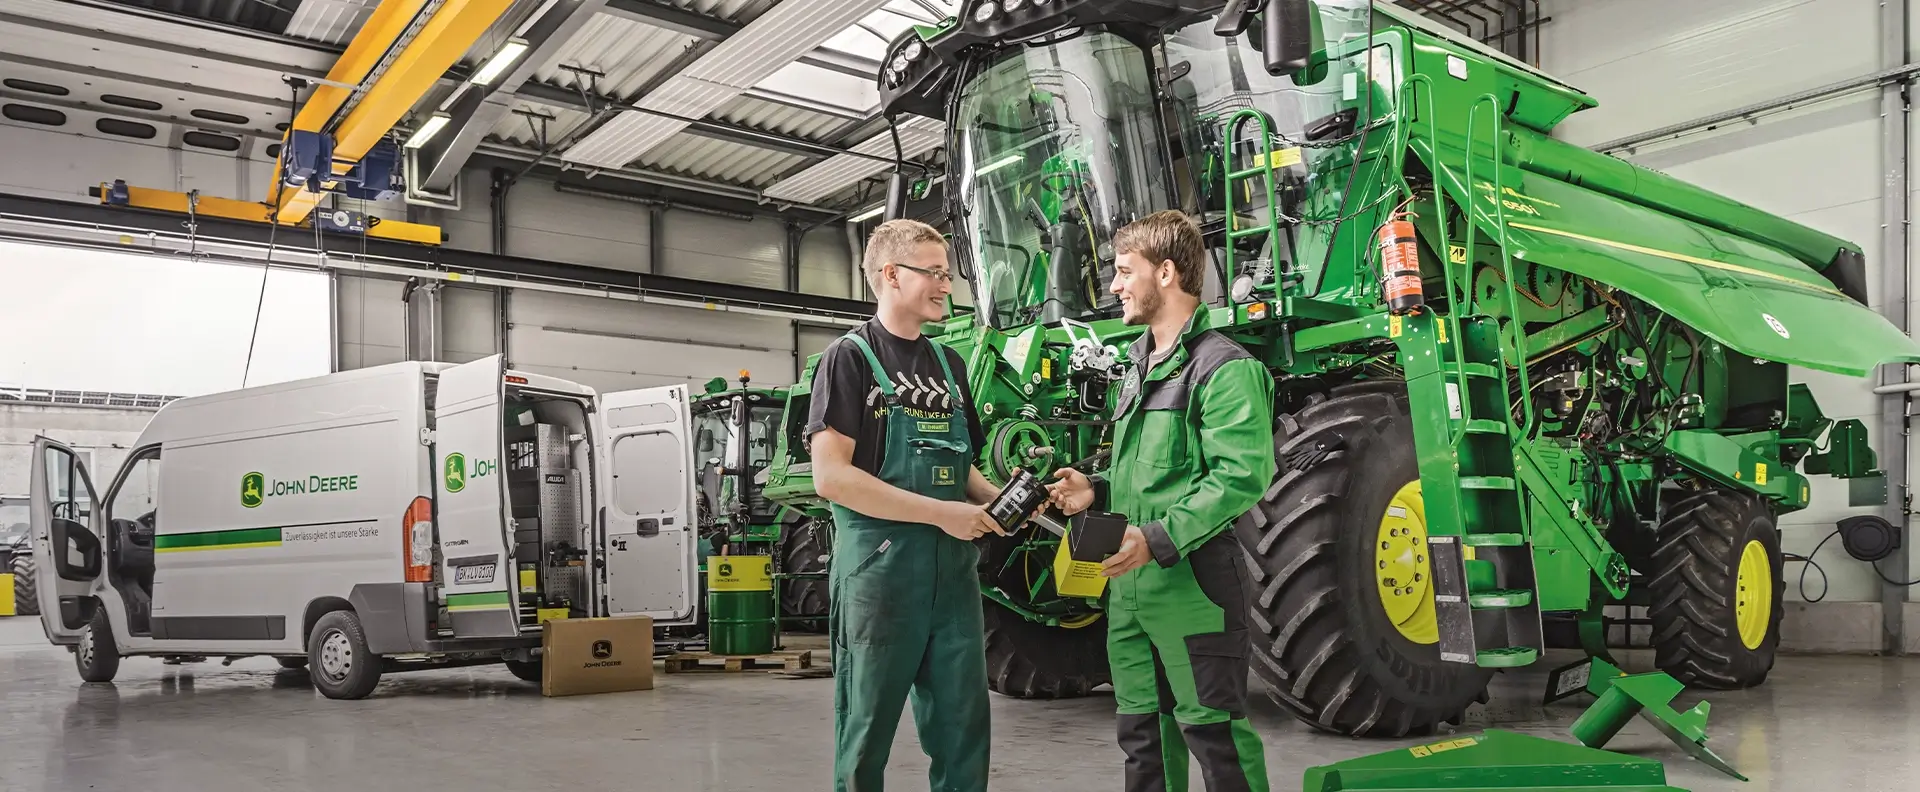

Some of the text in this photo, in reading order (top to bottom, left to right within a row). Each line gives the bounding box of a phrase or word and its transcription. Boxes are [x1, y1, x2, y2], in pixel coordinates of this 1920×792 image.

[904, 407, 923, 418] RUNS
[470, 458, 497, 478] JOH
[267, 475, 358, 497] JOHN DEERE
[285, 530, 328, 543] Zuverlässigkeit
[337, 530, 358, 539] unsere
[358, 526, 379, 538] Stärke
[583, 661, 600, 669] JOHN
